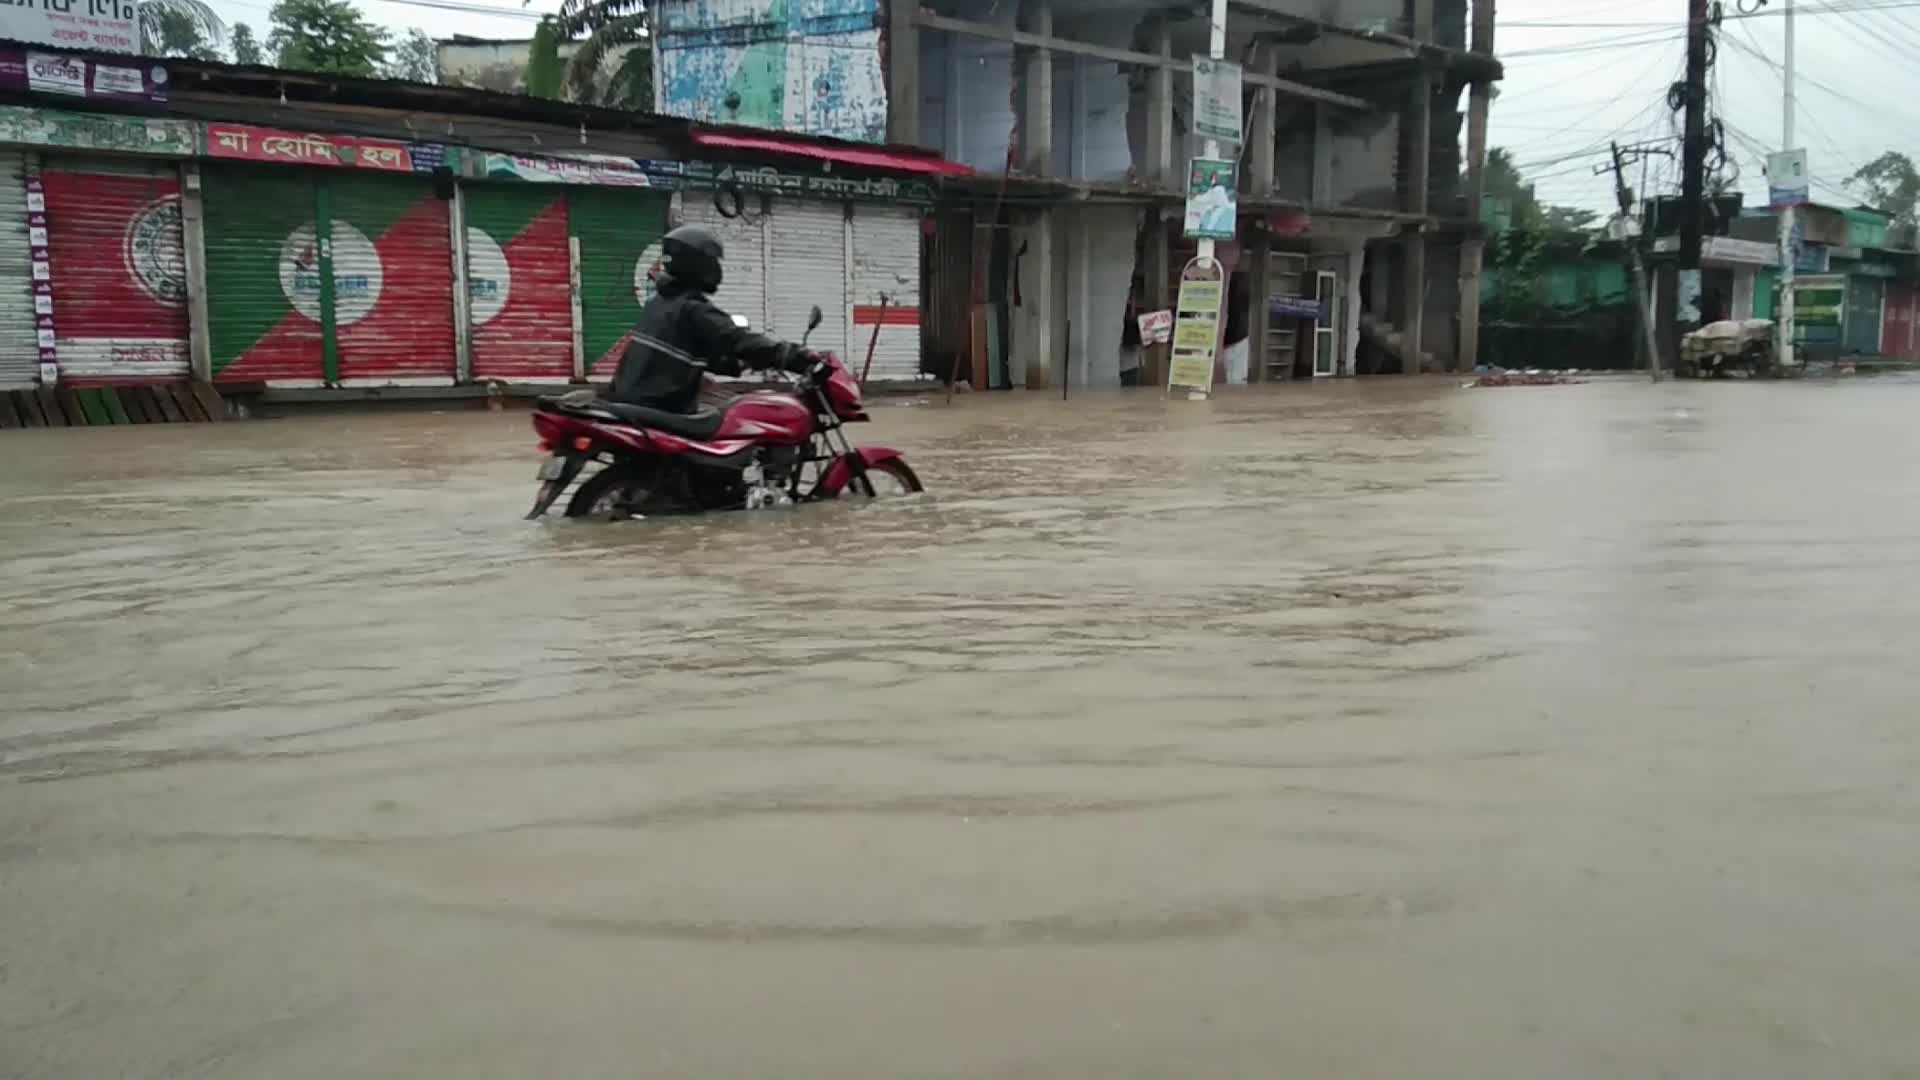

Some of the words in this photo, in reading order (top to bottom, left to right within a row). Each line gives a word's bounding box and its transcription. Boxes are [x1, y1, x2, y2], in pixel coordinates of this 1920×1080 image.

[214, 131, 249, 152] মা
[261, 134, 335, 161] হোমি
[360, 145, 401, 166] হল
